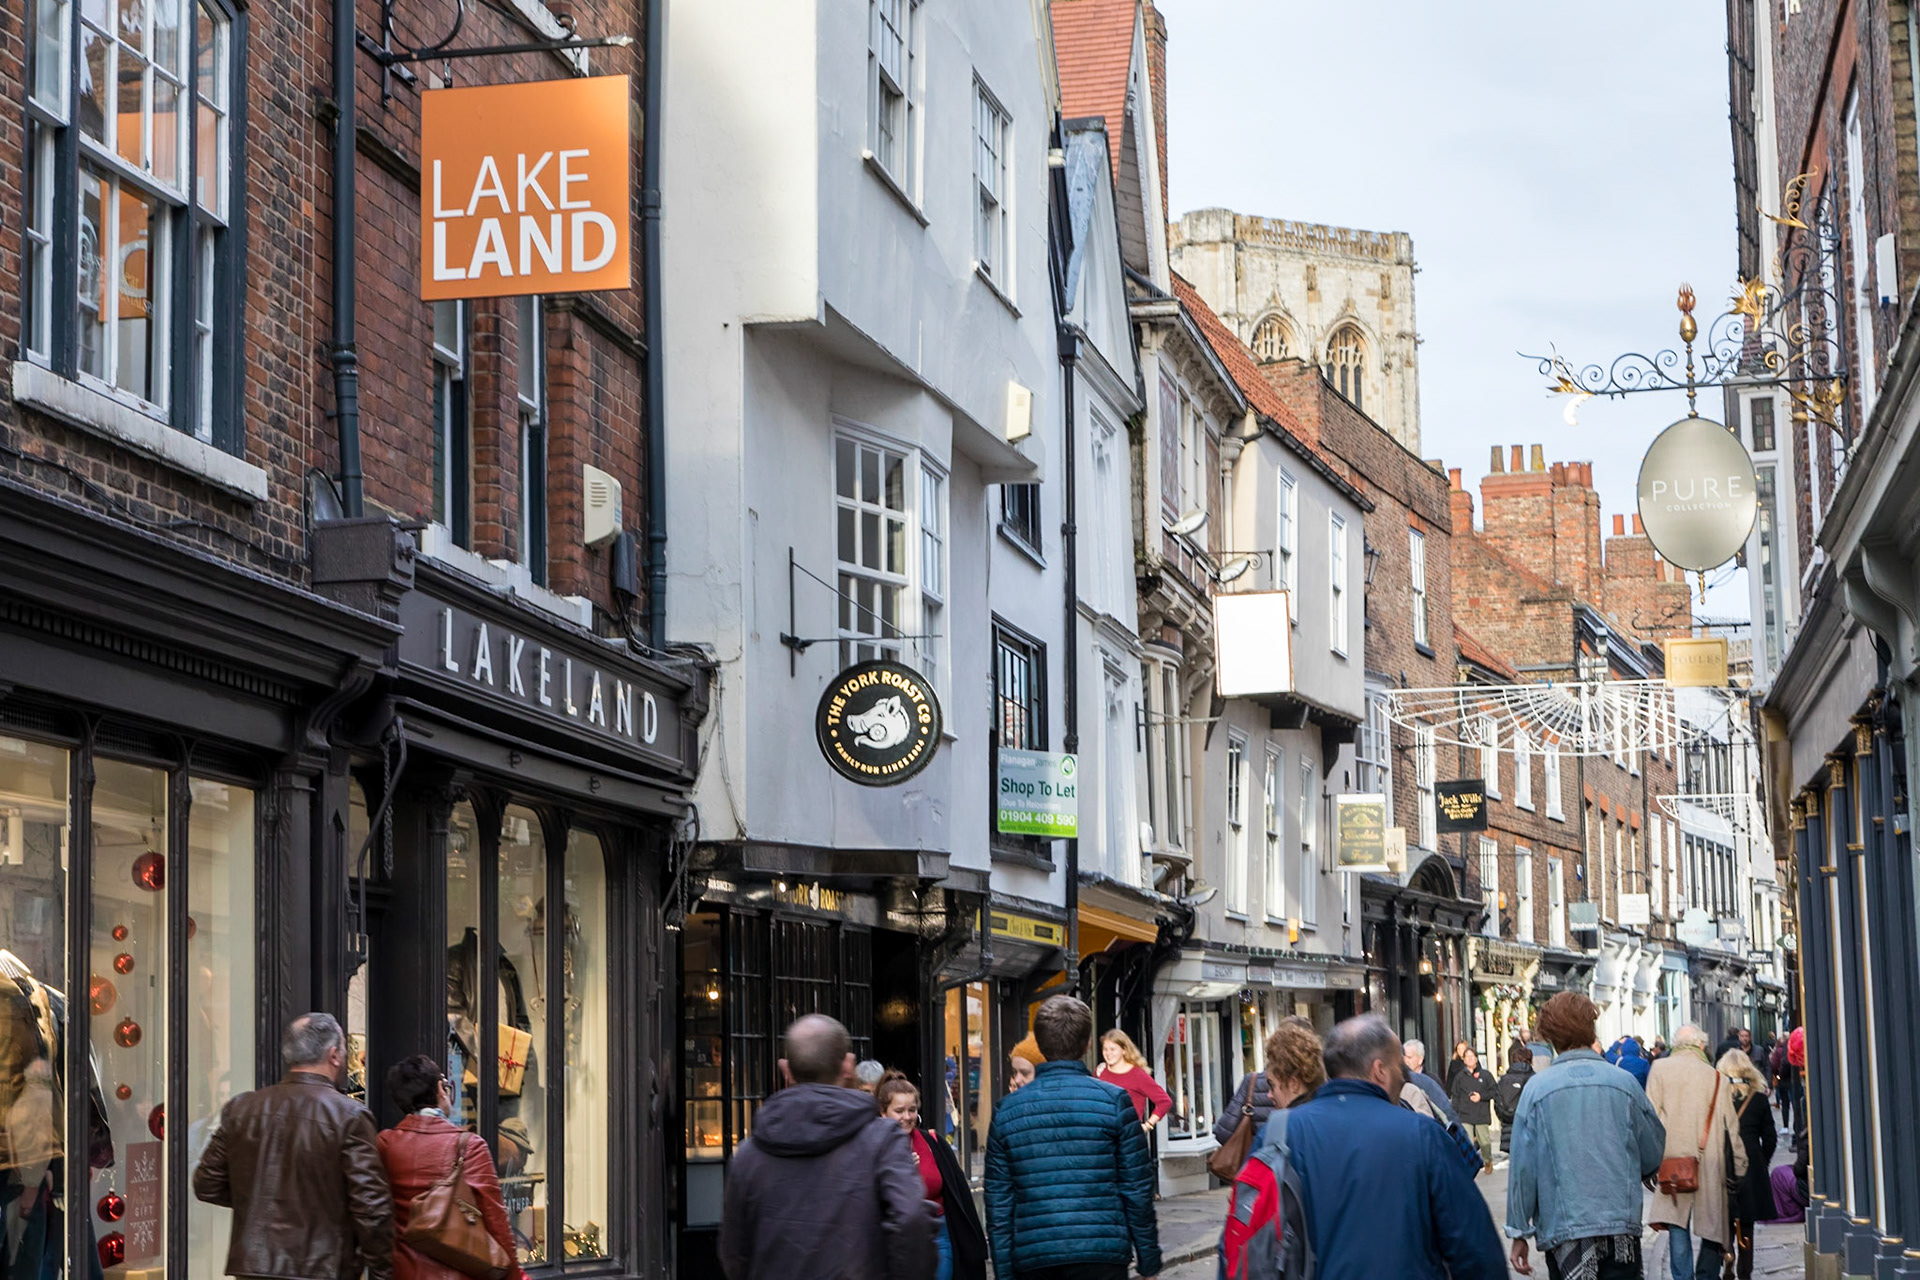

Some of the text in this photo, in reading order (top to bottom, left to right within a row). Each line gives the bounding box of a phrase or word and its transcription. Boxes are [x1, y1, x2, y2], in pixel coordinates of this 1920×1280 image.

[433, 148, 591, 218] LAKE
[433, 211, 617, 281] LAND
[1652, 475, 1743, 502] PURE
[1666, 502, 1731, 512] COLLECTION
[445, 607, 658, 744] LAKELAND
[827, 695, 846, 726] THE
[840, 671, 879, 697] YORK
[881, 670, 925, 703] ROAST
[834, 741, 861, 769] FAMILY
[860, 764, 880, 775] RUN
[881, 757, 909, 774] SINCE
[1001, 777, 1075, 798] Shop To Let
[1438, 792, 1482, 808] Jack Wills
[1000, 809, 1075, 827] 01904 409 590
[134, 1206, 153, 1217] GIFT
